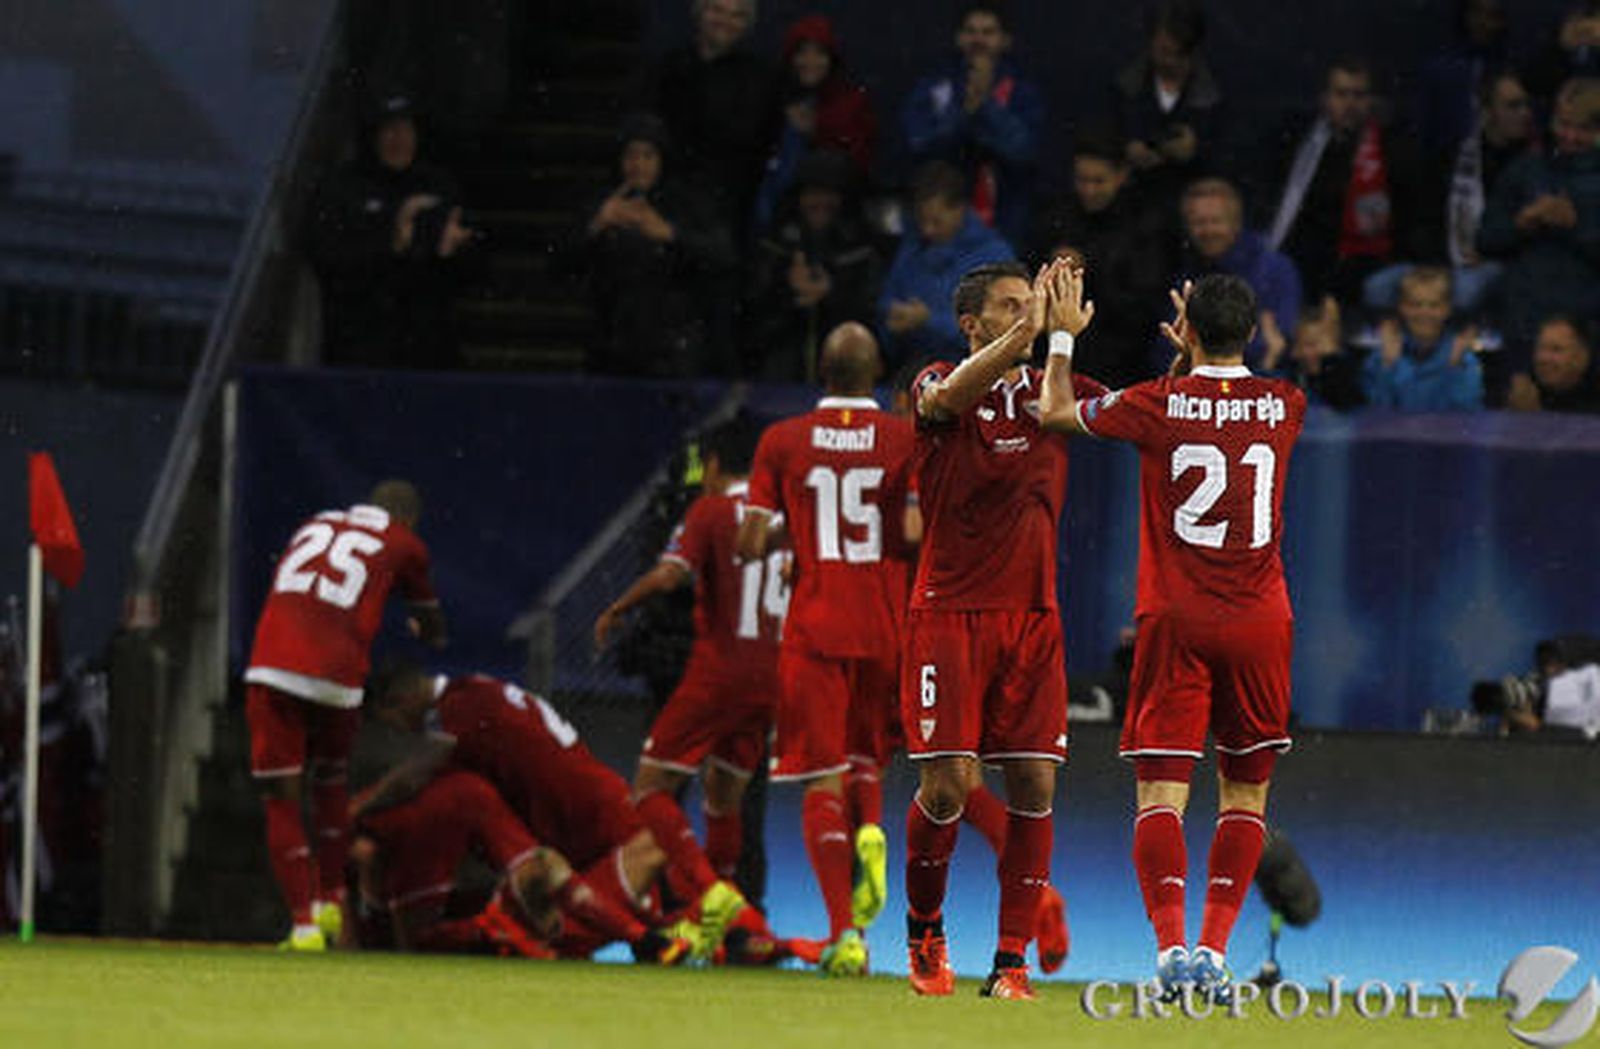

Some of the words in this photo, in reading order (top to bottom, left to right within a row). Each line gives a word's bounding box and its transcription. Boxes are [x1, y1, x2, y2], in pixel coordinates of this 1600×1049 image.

[1216, 392, 1285, 429] pareja
[805, 466, 884, 563] 15
[1171, 443, 1276, 549] 21
[274, 522, 384, 611] 25
[920, 664, 937, 708] 6
